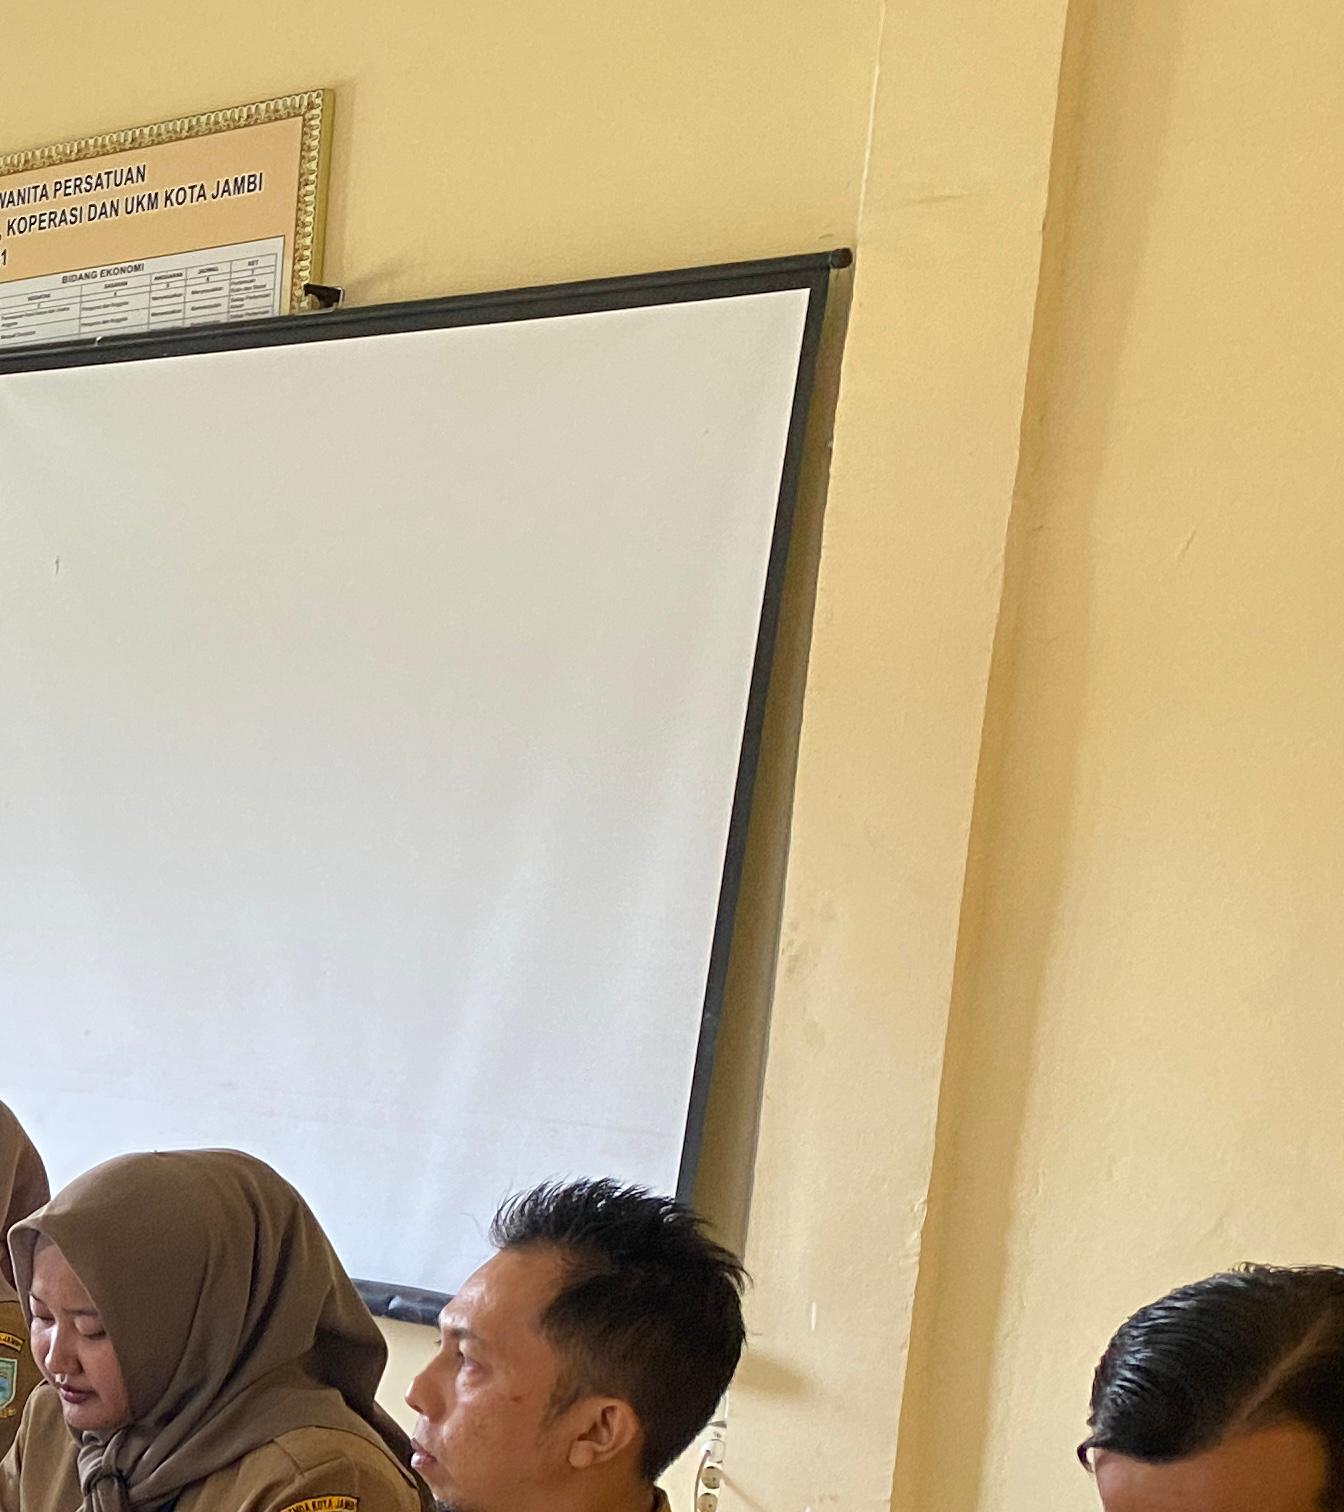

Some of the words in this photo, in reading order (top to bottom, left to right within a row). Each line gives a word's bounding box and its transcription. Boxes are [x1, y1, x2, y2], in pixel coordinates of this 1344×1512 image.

[53, 164, 146, 198] PERSATUAN
[6, 206, 82, 236] KOPERASI
[88, 199, 120, 222] DAN
[124, 192, 159, 215] UKM
[164, 183, 207, 208] KOTA
[212, 172, 263, 199] JAMBI
[62, 270, 98, 284] BIDANG
[99, 263, 145, 278] EKONOMI
[312, 1497, 332, 1512] KOTA
